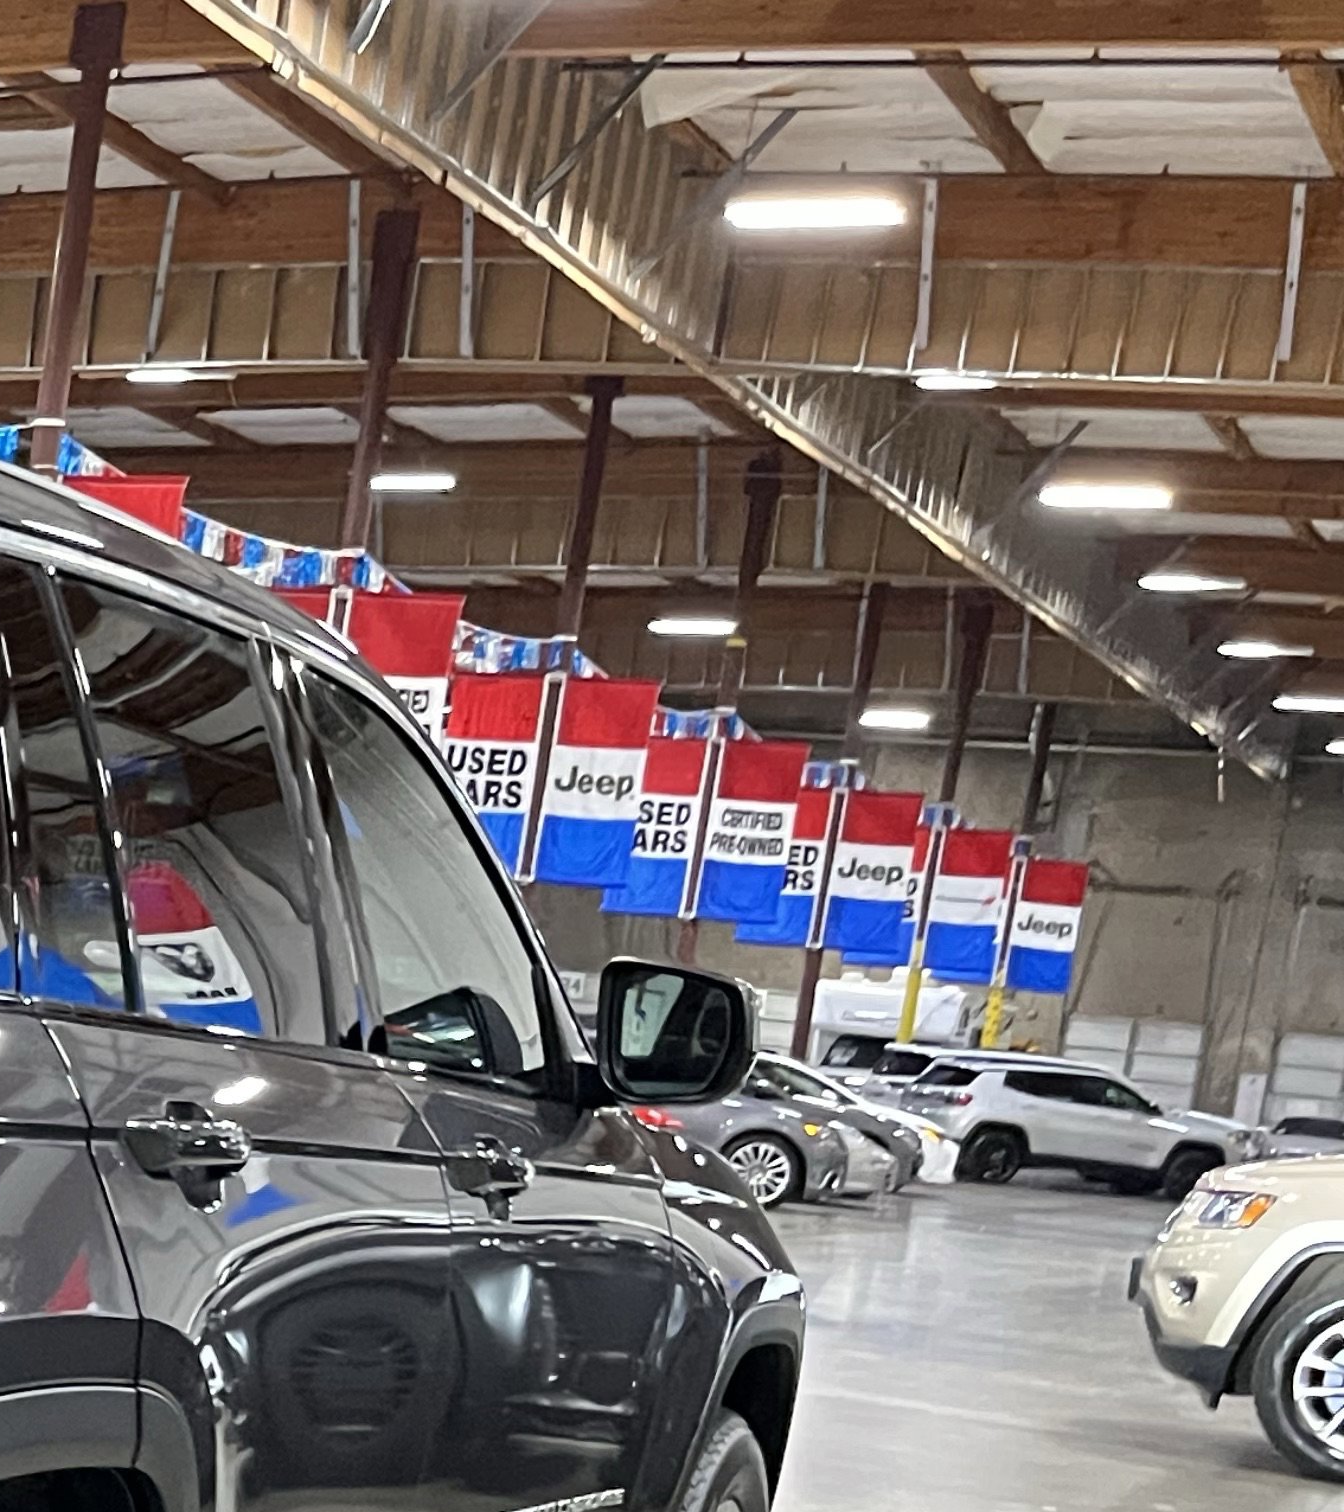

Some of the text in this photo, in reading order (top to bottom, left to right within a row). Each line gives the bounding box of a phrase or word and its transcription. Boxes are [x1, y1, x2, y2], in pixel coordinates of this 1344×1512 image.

[447, 744, 528, 777] USED
[465, 778, 523, 809] ARS
[554, 765, 635, 801] Jeep
[637, 799, 692, 826] SED
[720, 807, 783, 831] CERTIFIED
[631, 827, 689, 853] ARS
[709, 831, 785, 857] PRE-OWNED
[786, 844, 820, 867] ED
[782, 868, 816, 891] RS
[837, 857, 904, 886] Jeep
[1017, 914, 1073, 939] Jeep
